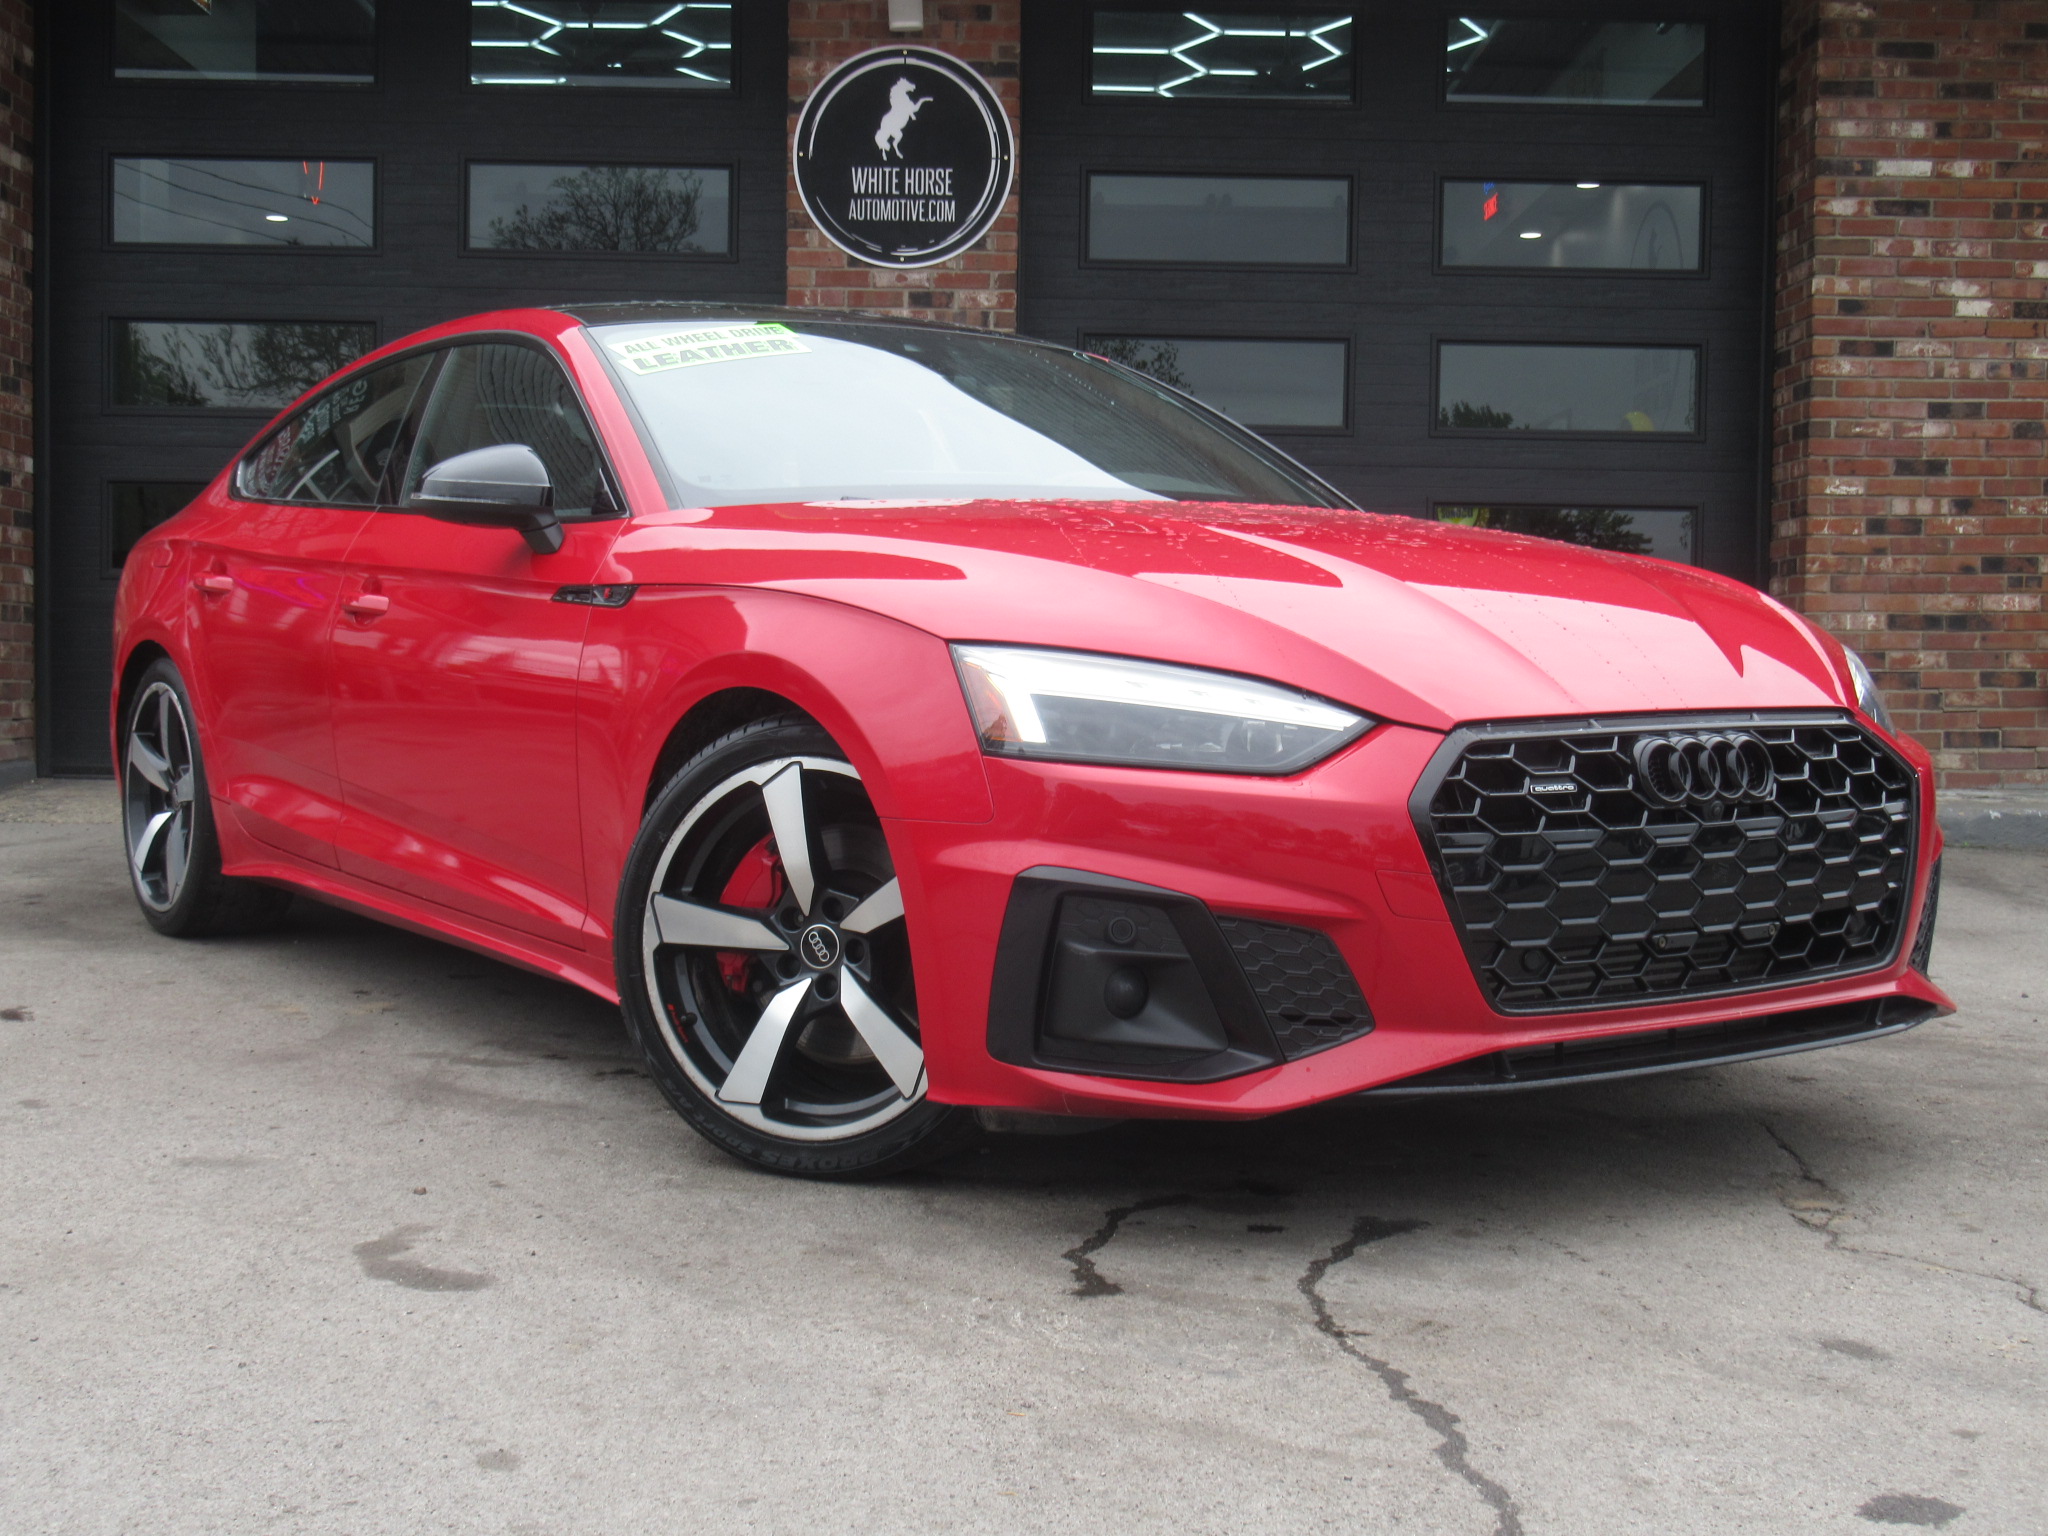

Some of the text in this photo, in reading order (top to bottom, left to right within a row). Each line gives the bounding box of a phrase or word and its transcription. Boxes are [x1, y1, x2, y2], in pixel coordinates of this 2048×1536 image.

[851, 166, 953, 196] WHITE HORSE
[848, 198, 956, 222] AUTOMOTIVE.COM
[624, 326, 785, 354] ALL WHEEL DRIVE
[632, 339, 794, 371] LEATHER
[1535, 784, 1575, 792] quattro
